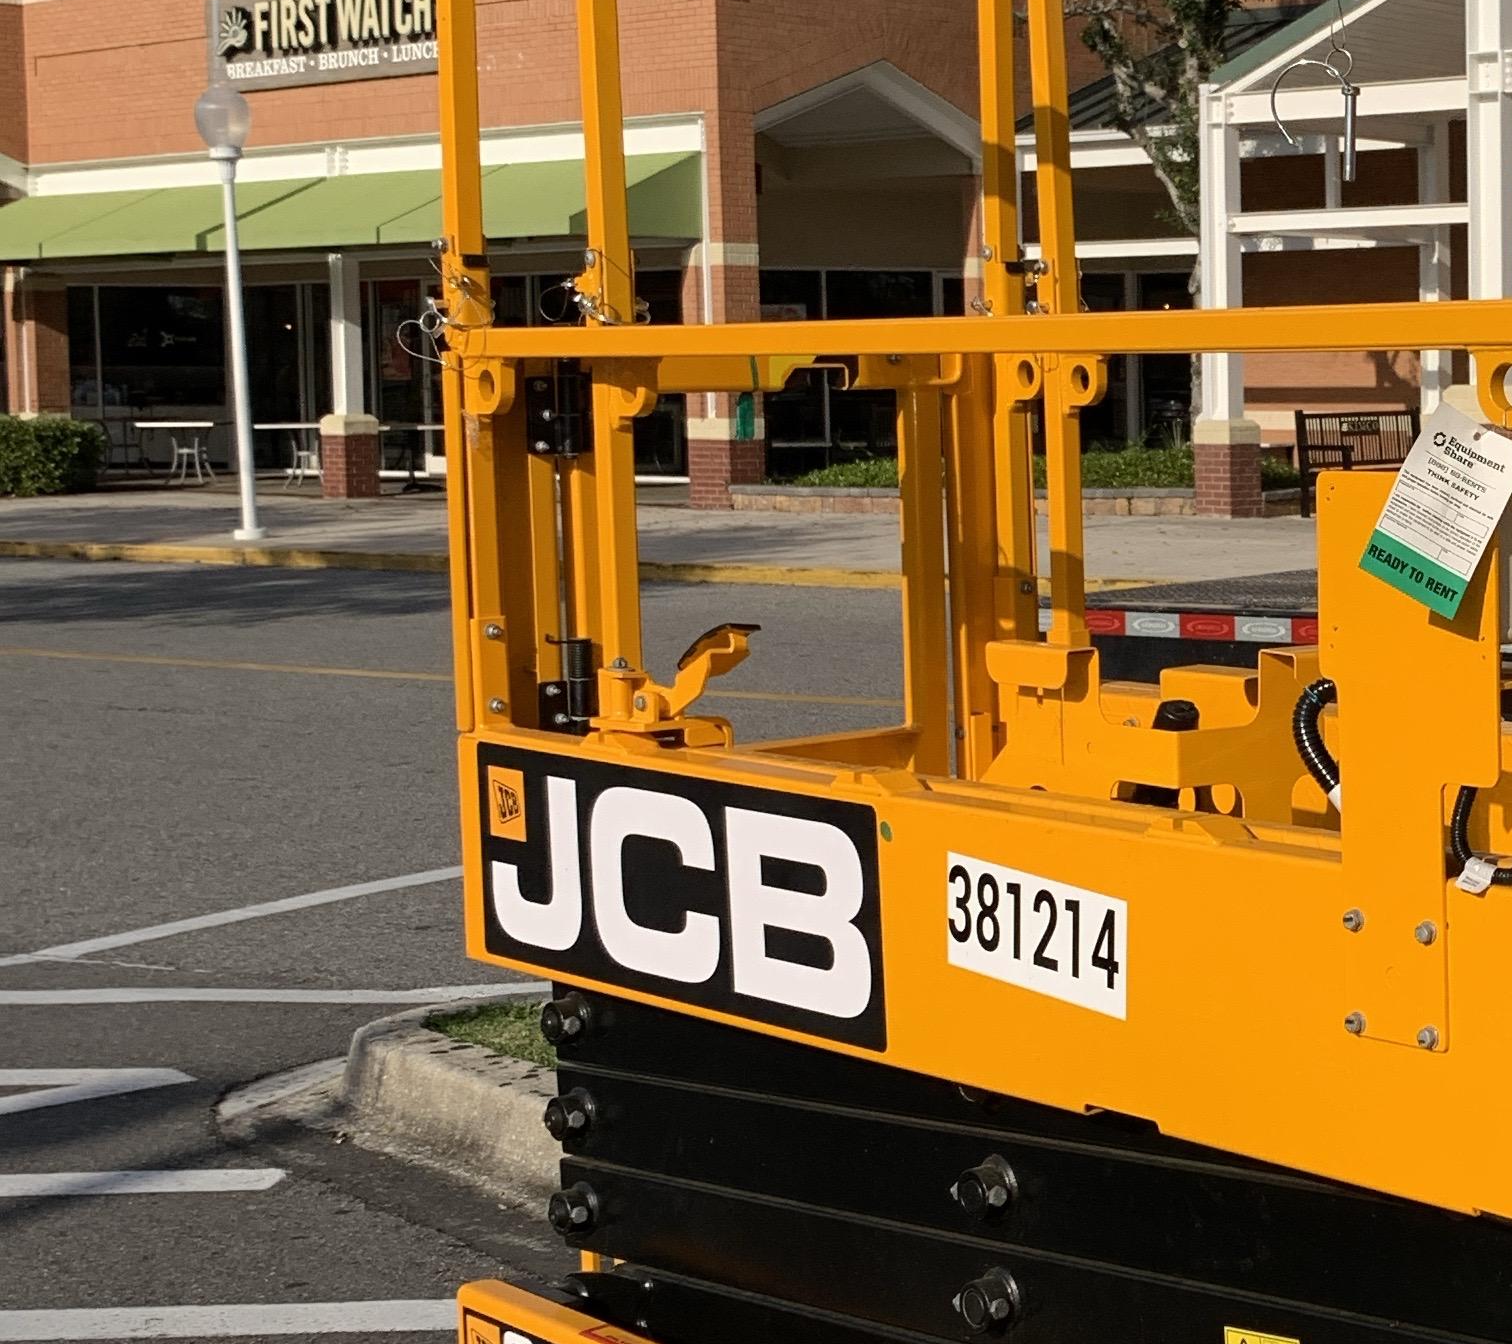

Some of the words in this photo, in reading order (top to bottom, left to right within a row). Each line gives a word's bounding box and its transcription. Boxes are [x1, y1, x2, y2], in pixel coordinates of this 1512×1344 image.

[227, 56, 306, 80] BREAKFAST
[319, 47, 379, 71] BRUNCH
[1443, 446, 1474, 470] Share
[1448, 436, 1506, 474] Equipment
[1427, 468, 1451, 486] THINK
[1450, 482, 1480, 501] SAFETY
[1367, 543, 1408, 575] READY
[1408, 564, 1425, 585] TO
[1424, 575, 1459, 603] RENT
[490, 774, 873, 1019] JCB
[947, 864, 1119, 990] 381214
